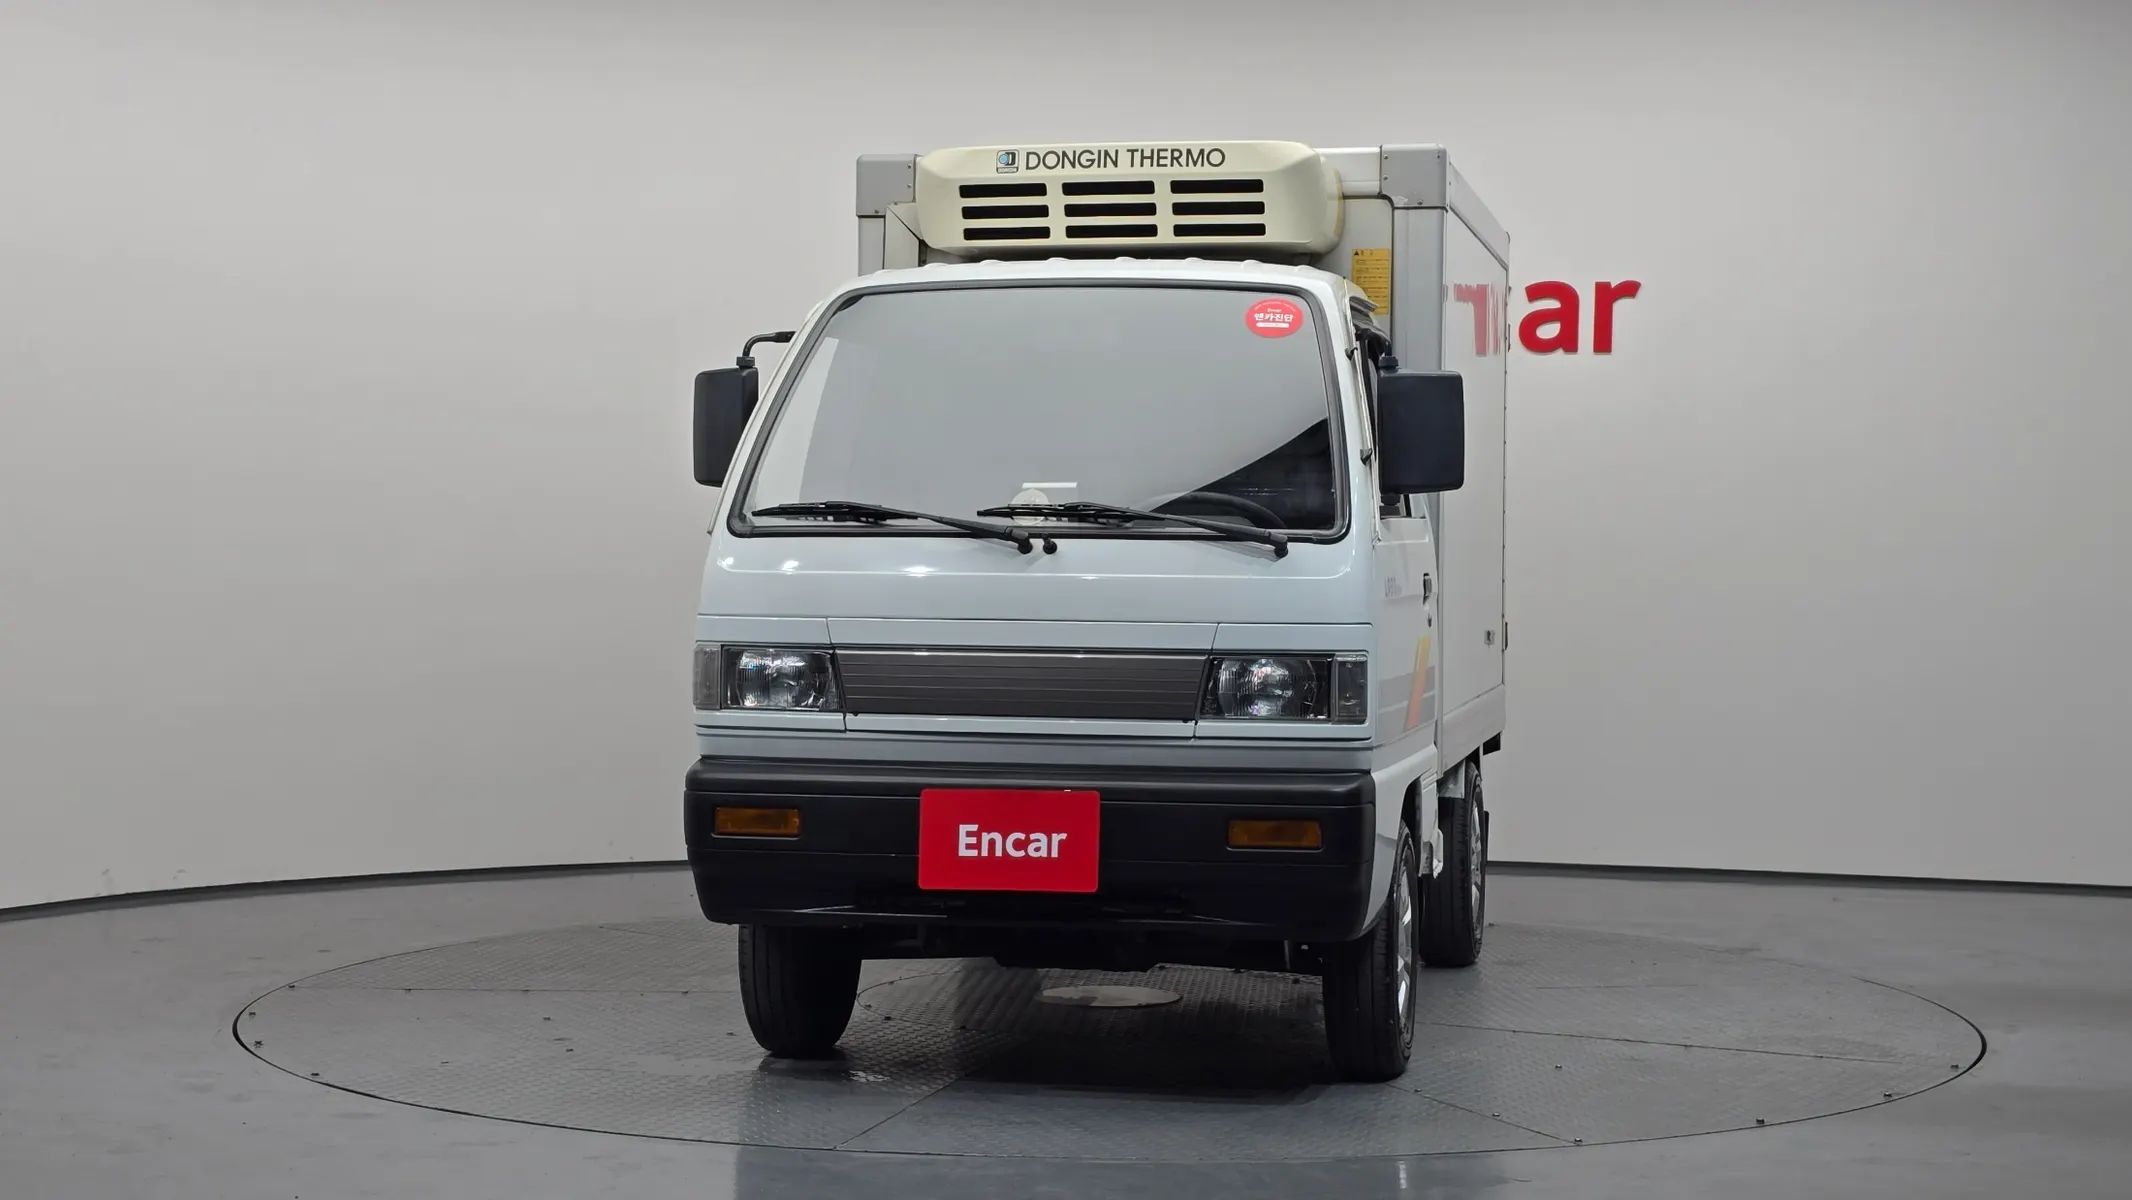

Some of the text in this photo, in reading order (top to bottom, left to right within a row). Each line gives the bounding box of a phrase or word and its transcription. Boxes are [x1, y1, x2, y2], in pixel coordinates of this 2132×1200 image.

[1025, 148, 1226, 170] DONGIN THERMO
[1518, 280, 1642, 354] ar
[958, 824, 1067, 858] Encar
